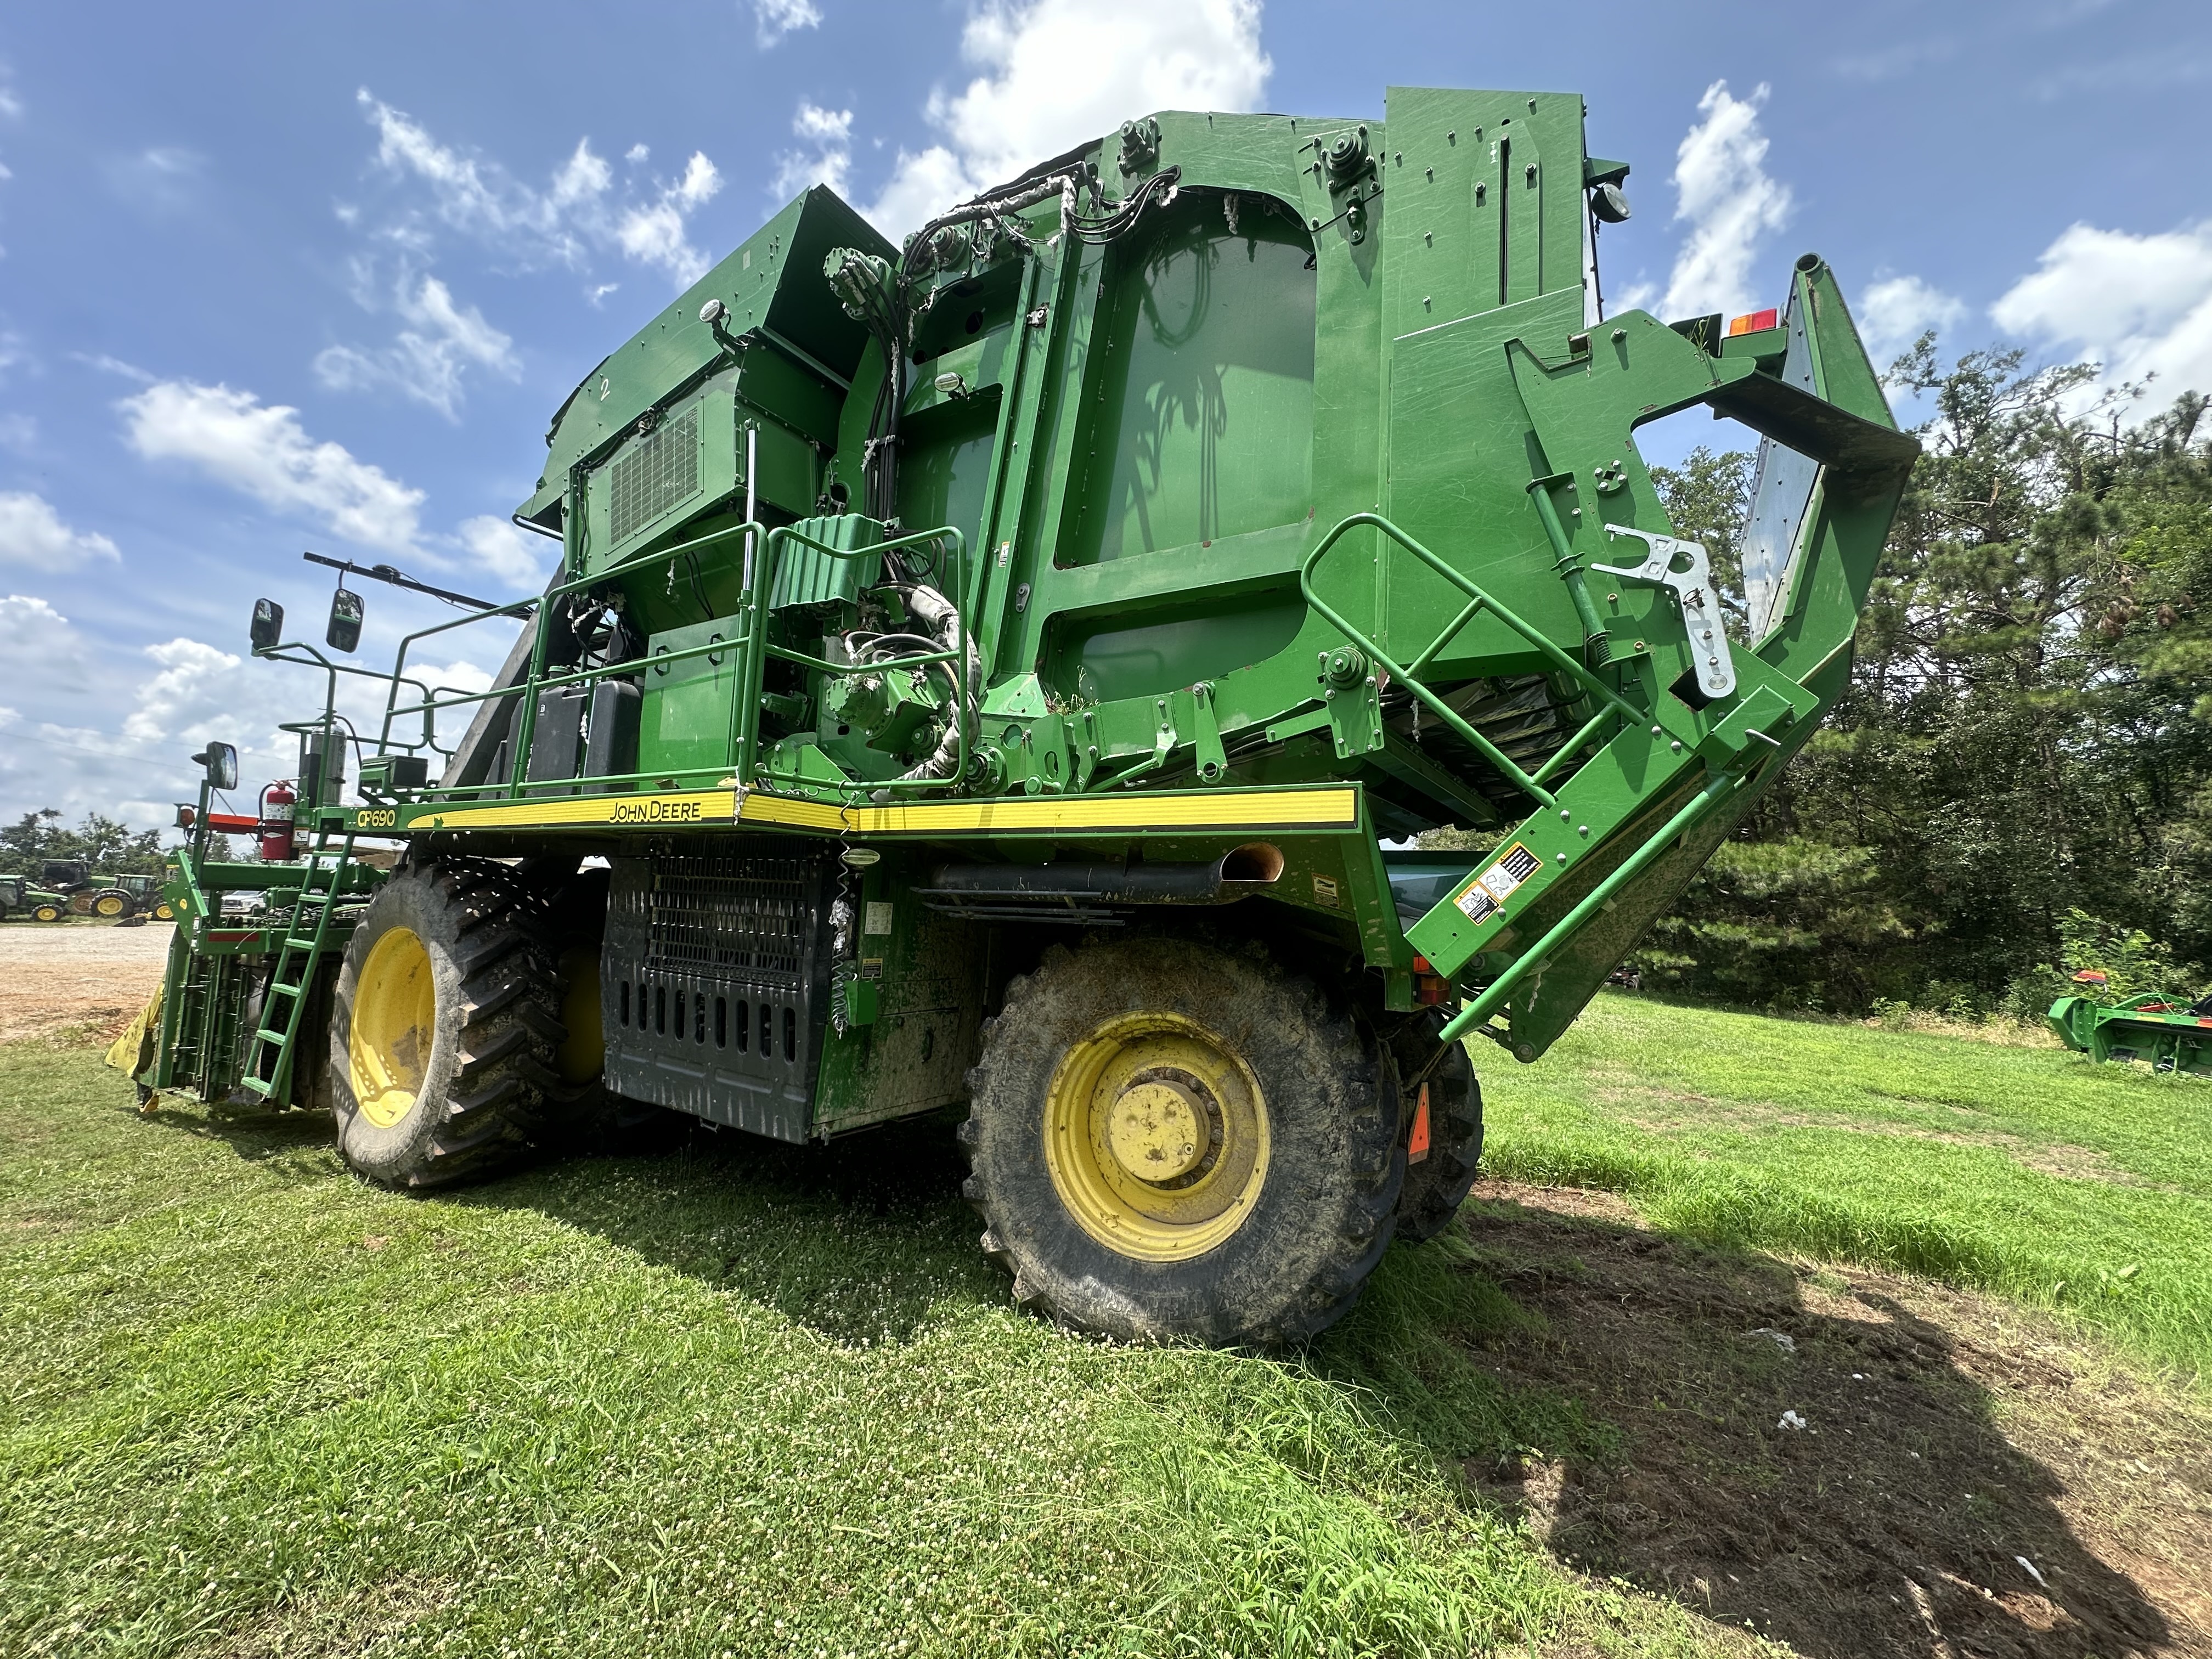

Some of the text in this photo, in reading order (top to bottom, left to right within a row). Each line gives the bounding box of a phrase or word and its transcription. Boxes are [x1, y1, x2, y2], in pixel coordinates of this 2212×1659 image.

[601, 379, 610, 401] 2
[610, 800, 702, 821] JOHN DEERE
